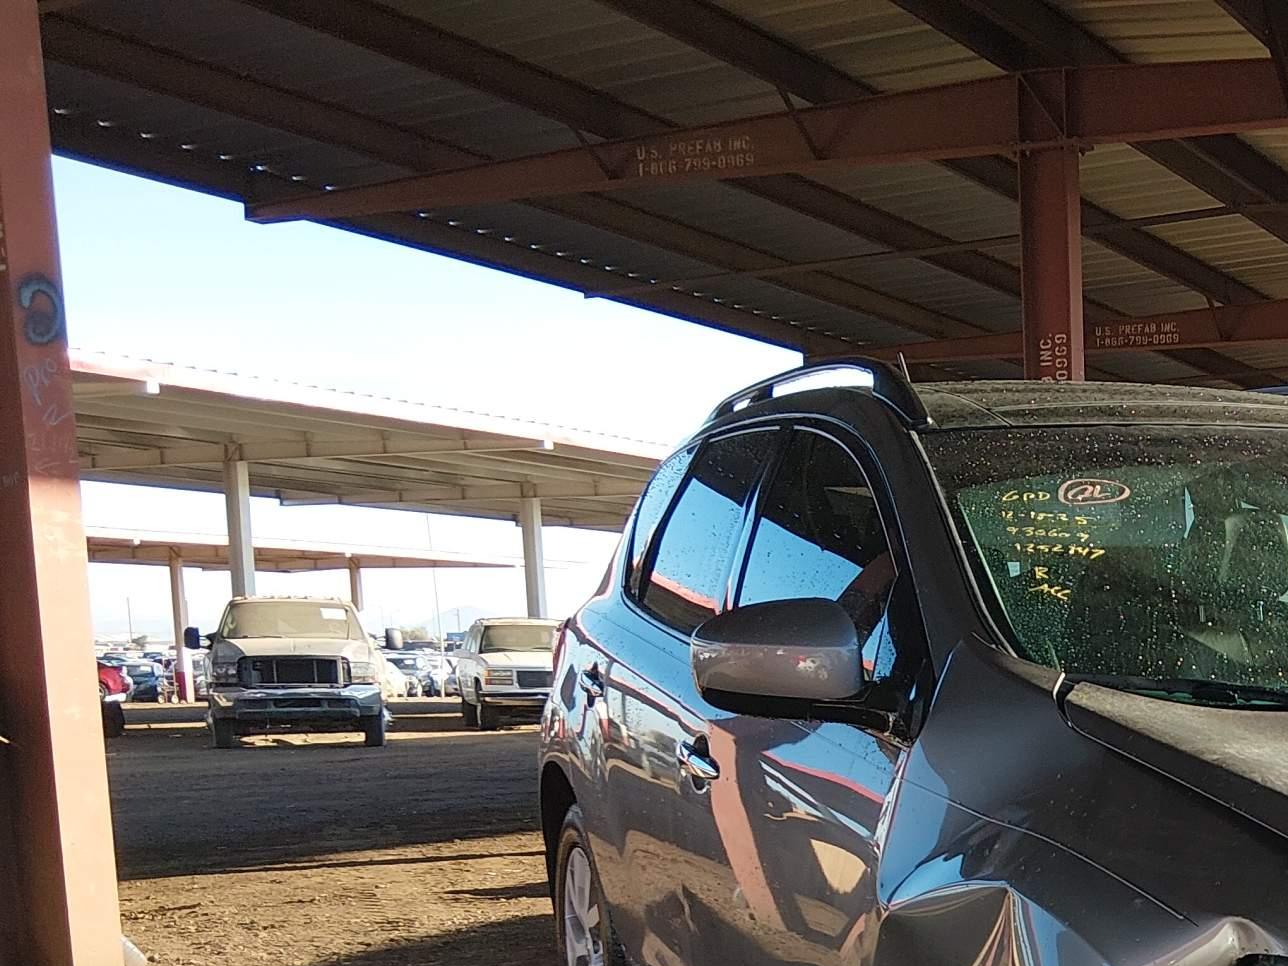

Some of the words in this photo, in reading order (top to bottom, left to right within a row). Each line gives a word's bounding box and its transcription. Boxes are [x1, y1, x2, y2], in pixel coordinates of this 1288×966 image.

[636, 145, 662, 160] U.S.
[670, 139, 721, 156] PREFAB
[1095, 326, 1114, 337] U.S.
[1119, 323, 1157, 335] PREFAB
[1161, 321, 1180, 333] INC.
